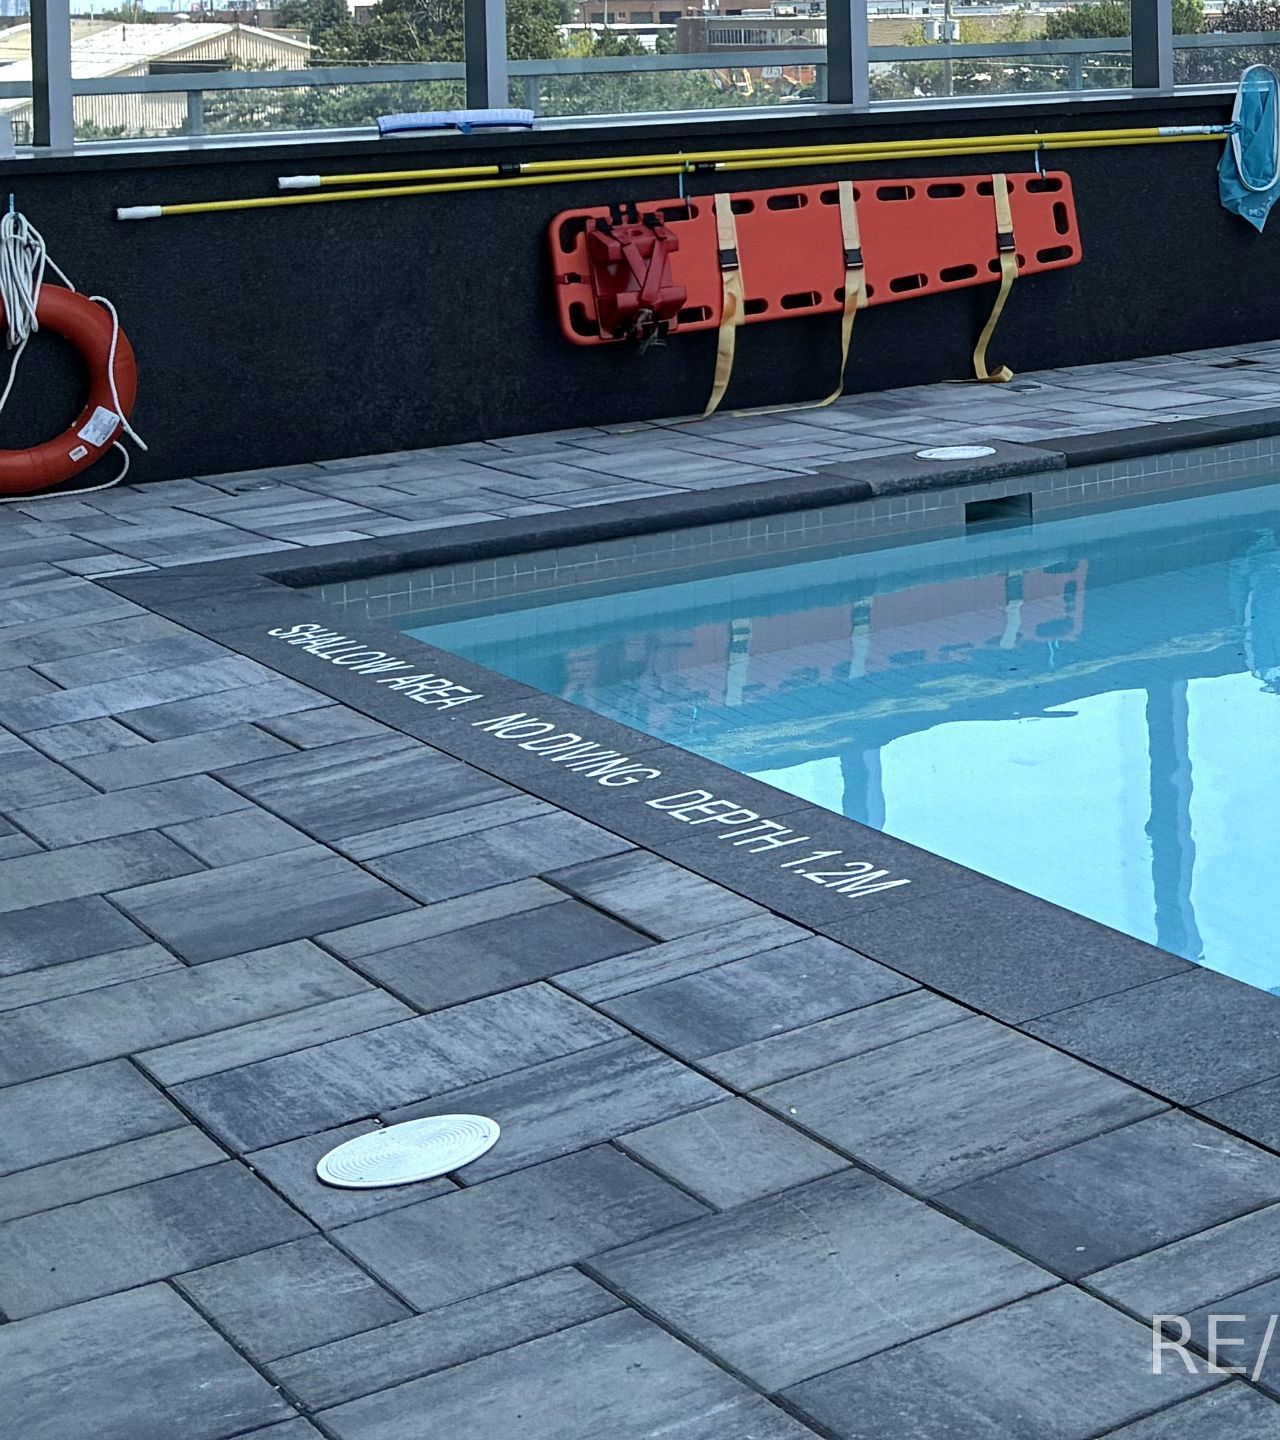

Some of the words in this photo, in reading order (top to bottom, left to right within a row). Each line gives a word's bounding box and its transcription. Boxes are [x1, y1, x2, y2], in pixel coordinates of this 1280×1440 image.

[268, 623, 415, 675] SHALLOW
[376, 673, 485, 711] AREA
[471, 712, 555, 739] NO
[518, 733, 662, 787] DIVING
[644, 789, 811, 854] DEPTH
[780, 850, 912, 898] 1.2M
